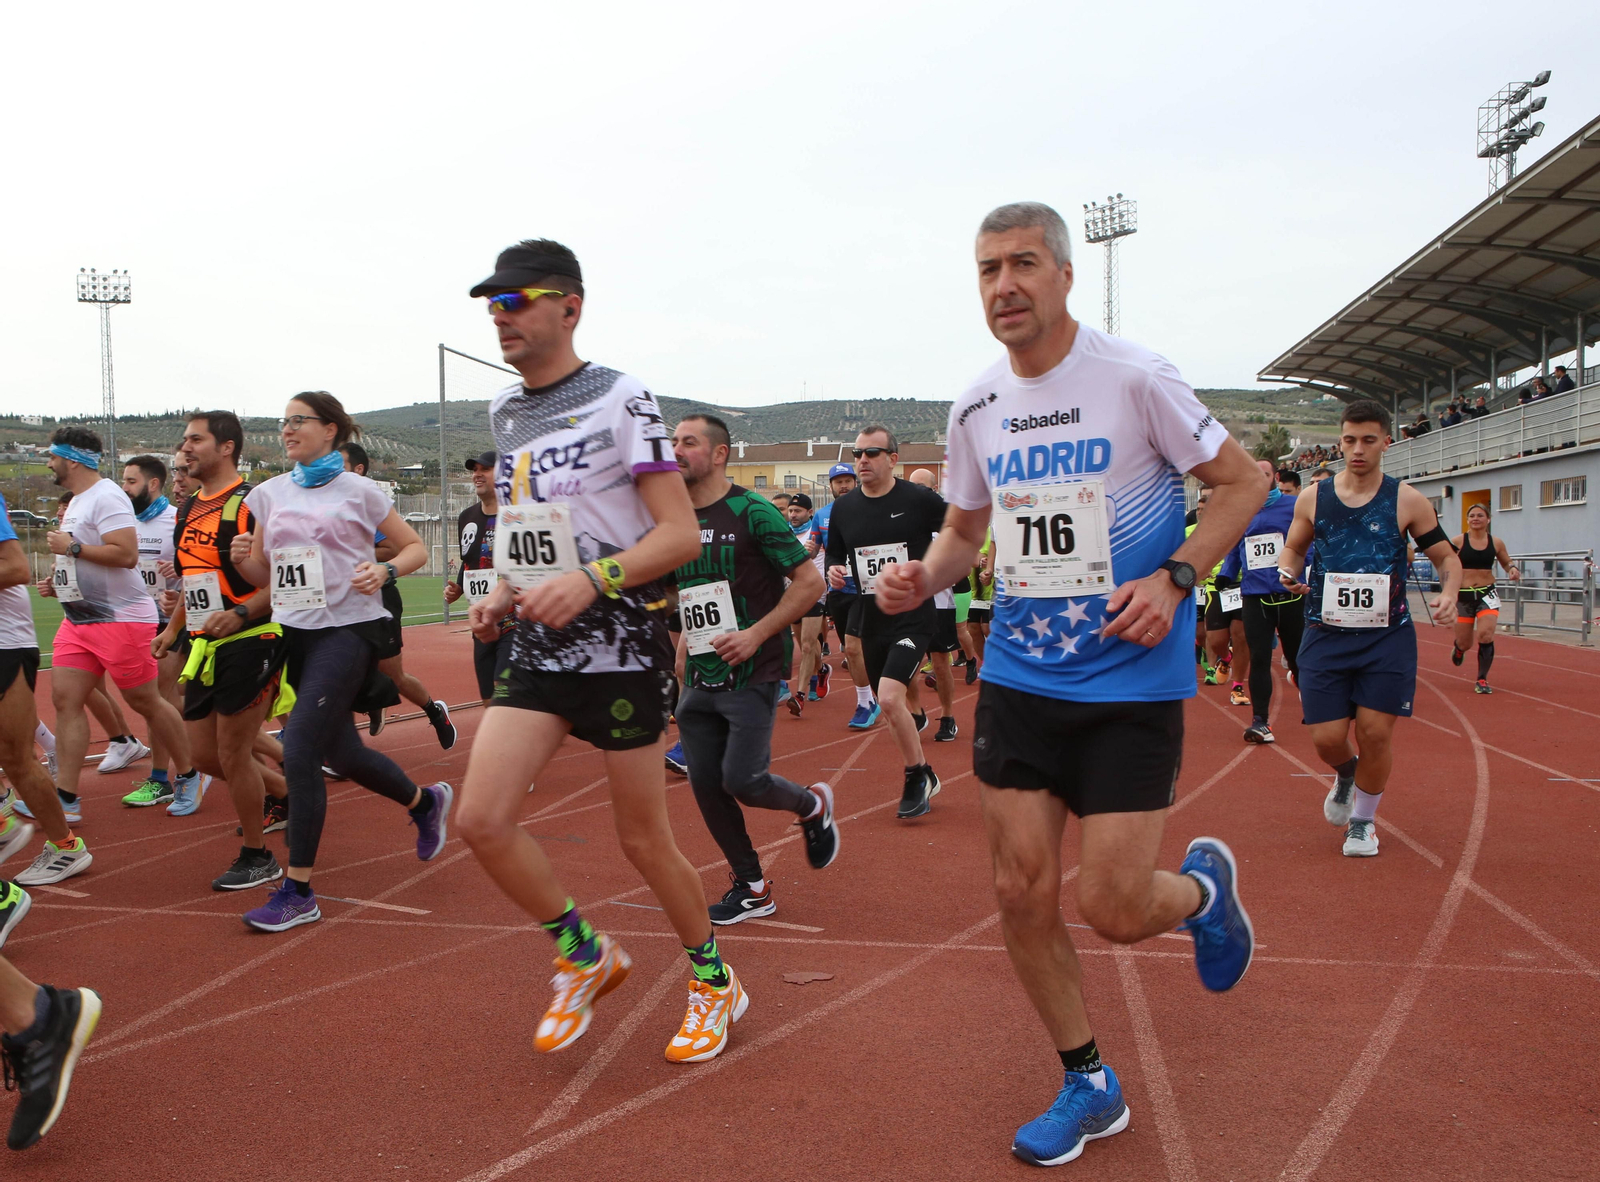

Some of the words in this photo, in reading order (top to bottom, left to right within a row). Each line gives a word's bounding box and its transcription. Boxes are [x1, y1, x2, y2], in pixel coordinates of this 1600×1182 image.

[1010, 407, 1080, 433] Sabadell
[987, 437, 1111, 488] MADRID
[508, 530, 557, 565] 405
[1016, 513, 1075, 556] 716
[1253, 542, 1276, 557] 373
[276, 564, 307, 588] 241
[469, 580, 489, 596] 812
[1337, 587, 1374, 608] 513
[684, 601, 721, 631] 666
